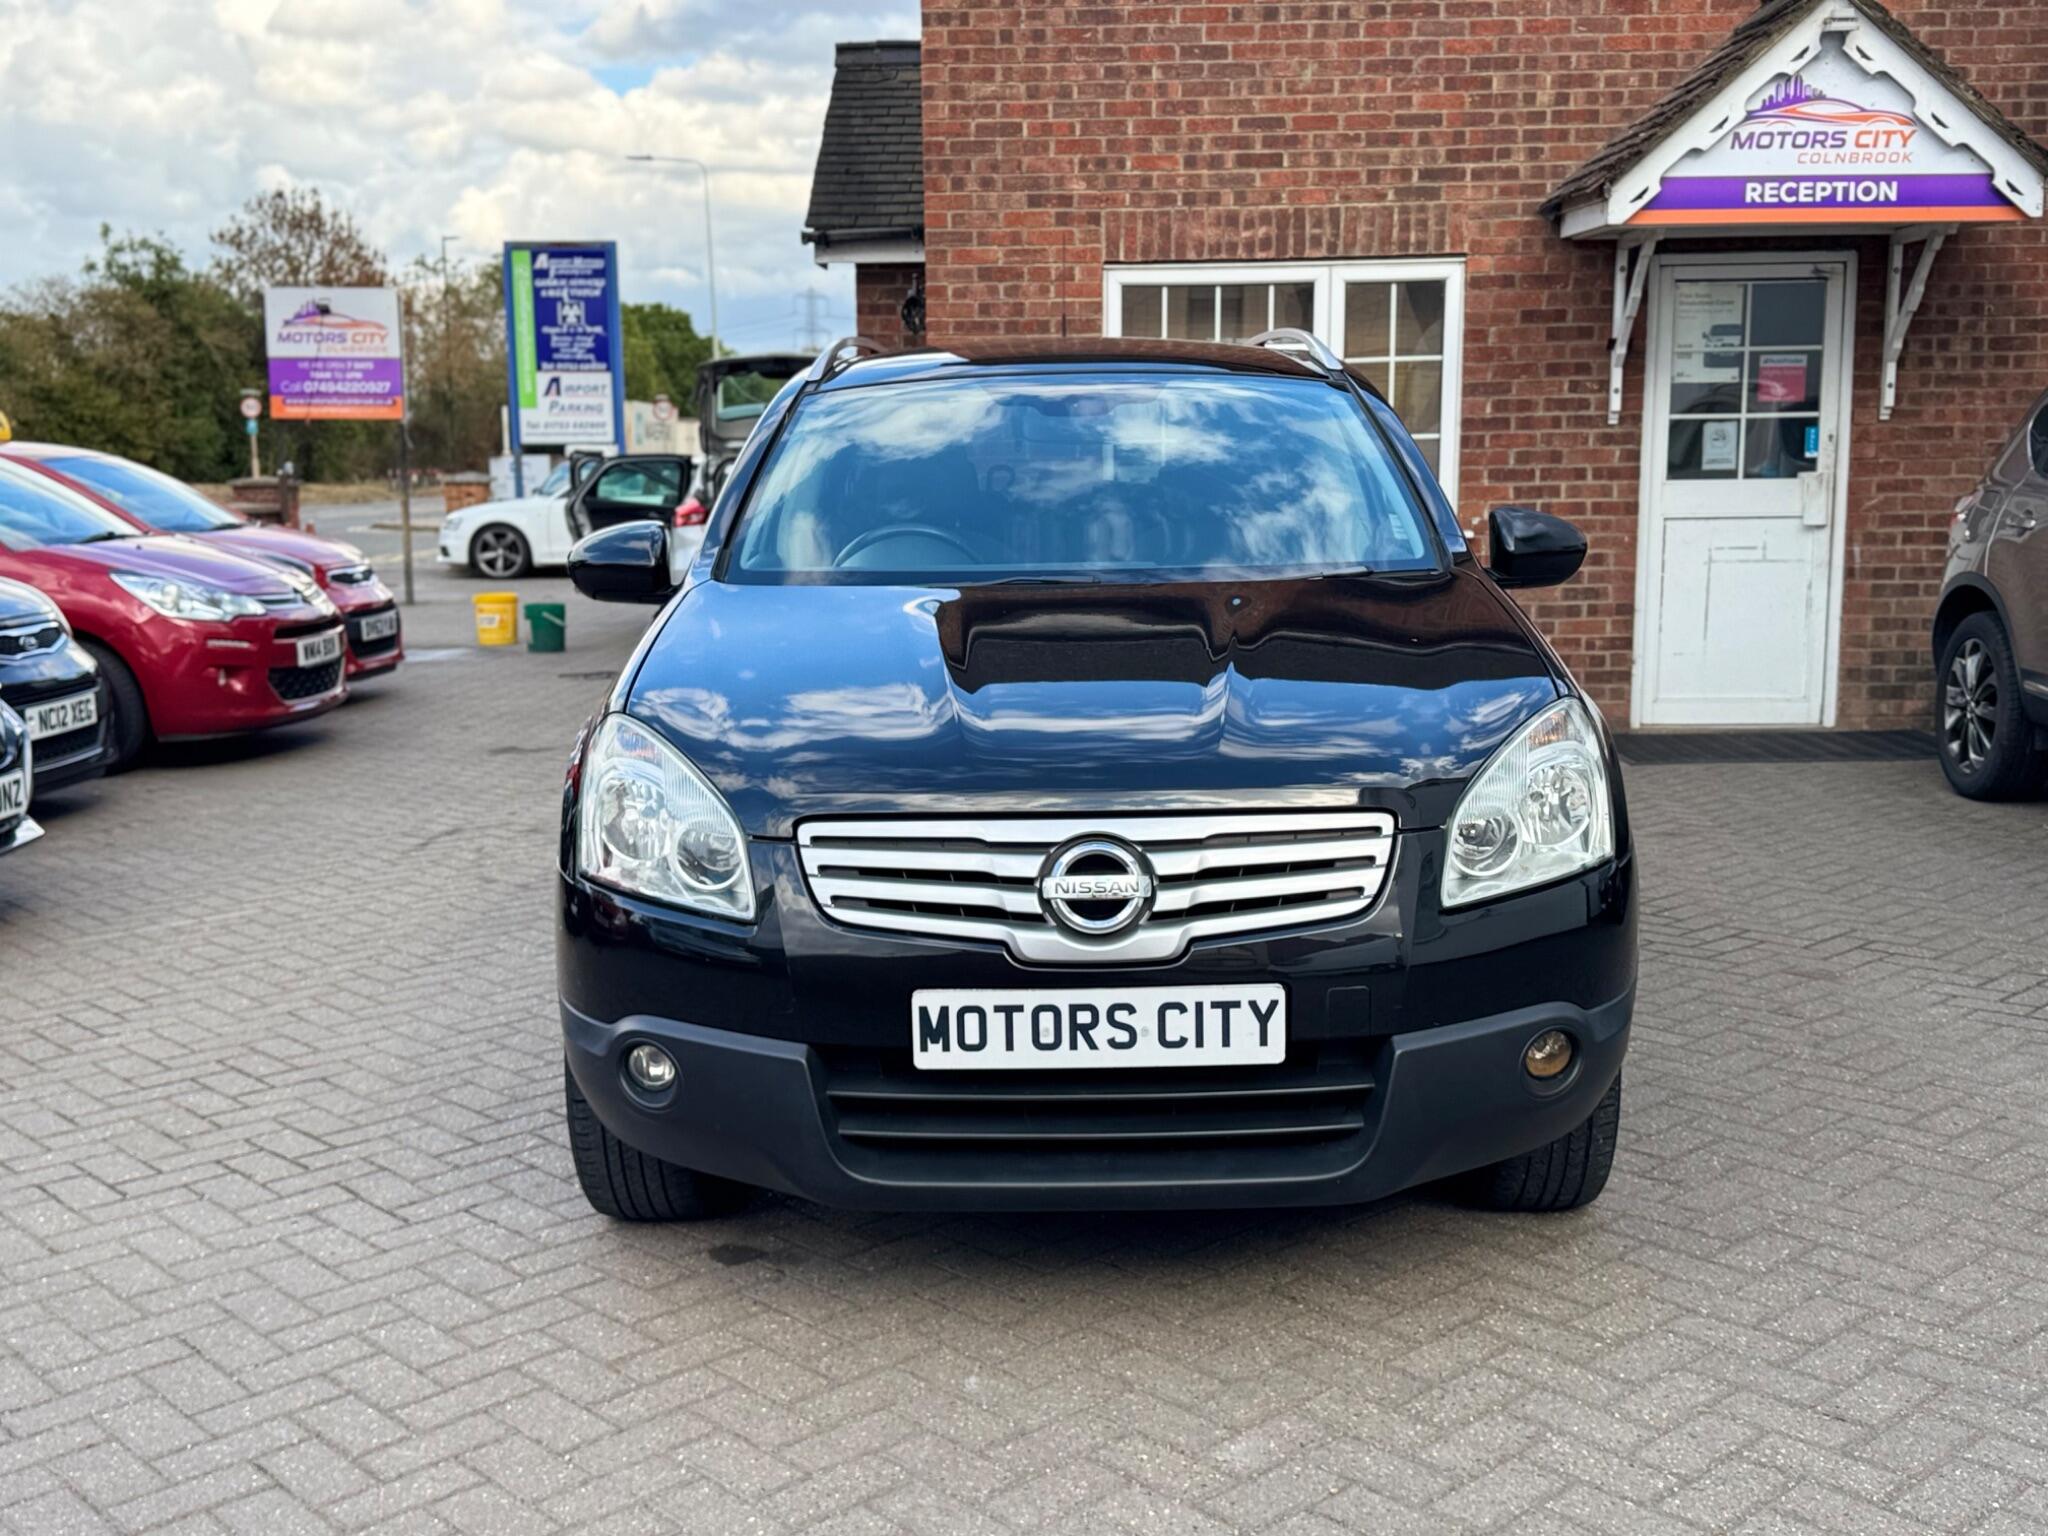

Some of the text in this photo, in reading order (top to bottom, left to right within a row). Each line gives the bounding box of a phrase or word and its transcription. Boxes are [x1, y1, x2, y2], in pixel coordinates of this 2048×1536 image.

[1730, 129, 1918, 151] MOTORS CITY
[1797, 152, 1913, 165] COLNBROOK
[1745, 181, 1898, 204] RECEPTION
[277, 331, 389, 344] MOTORS CITY
[280, 380, 301, 393] Call
[549, 400, 604, 414] PARKING
[38, 706, 69, 734] NC12
[1054, 881, 1140, 895] NISSAN
[918, 999, 1280, 1052] MOTORS CITY
